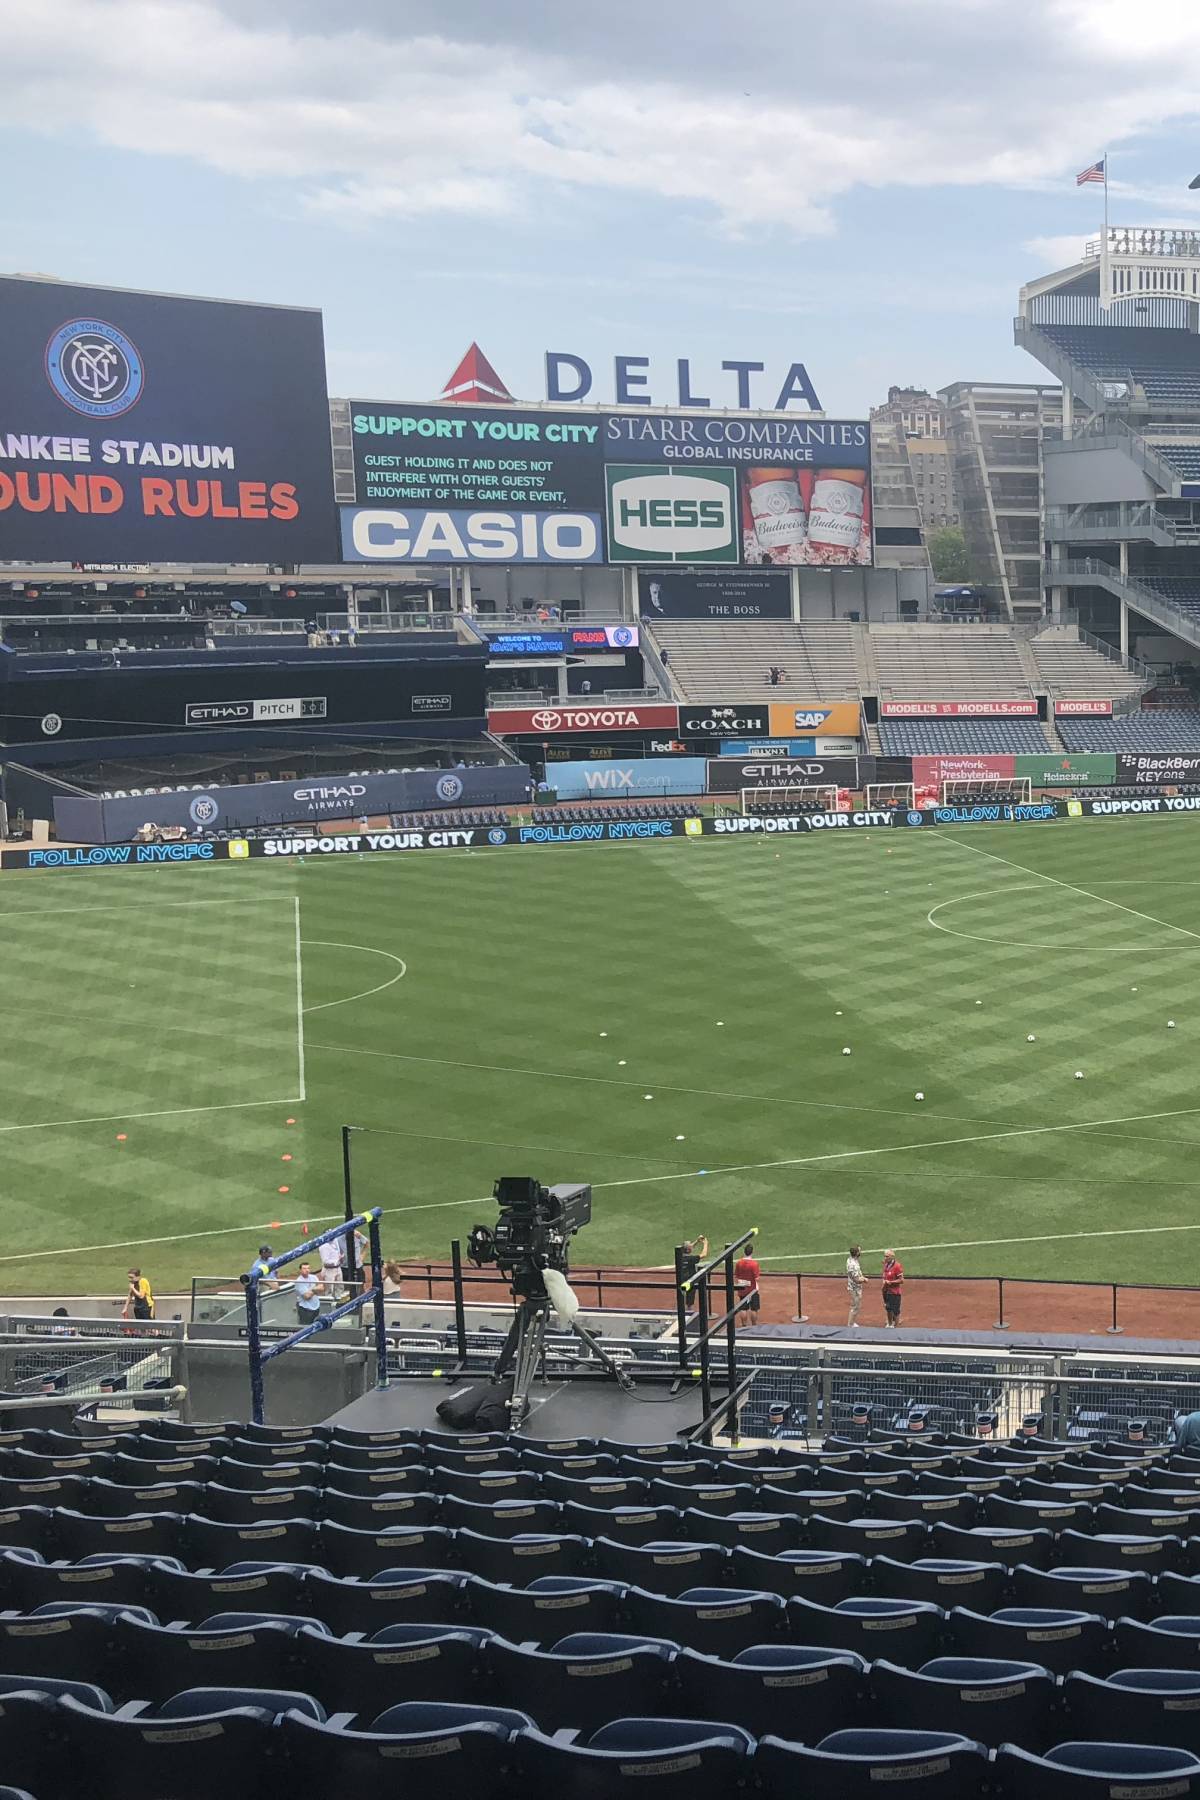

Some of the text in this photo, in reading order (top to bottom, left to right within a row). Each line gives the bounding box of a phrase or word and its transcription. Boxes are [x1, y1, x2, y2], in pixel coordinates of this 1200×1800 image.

[80, 323, 104, 332] YORK
[105, 329, 124, 343] CITY
[546, 351, 823, 411] DELTA
[353, 415, 599, 443] SUPPORT YOUR CITY
[607, 417, 866, 446] STARR COMPANIES
[102, 440, 235, 469] STADIUM
[663, 445, 813, 461] GLOBAL INSURANCE
[365, 455, 553, 472] GUEST HOLDING IT AND DOES NOT
[366, 472, 545, 487] INTERFERE WITH OTHER GUESTS'
[142, 477, 299, 519] RULES
[367, 487, 567, 503] ENJOYMENT OF THE GAME OR EVENT,
[620, 499, 724, 528] HESS
[352, 510, 597, 560] CASIO
[708, 605, 761, 615] THE BOSS
[573, 631, 605, 643] FANS
[526, 641, 564, 651] MATCH
[414, 697, 449, 705] ETIHAD
[886, 704, 938, 713] MODELL'S
[957, 703, 1033, 713] MODELLS.com
[1060, 703, 1107, 712] MODELL'S
[191, 704, 294, 718] ETIHAD PITCH
[563, 711, 640, 727] TOYOTA
[686, 719, 762, 730] COACH
[795, 712, 826, 727] SAP
[651, 740, 687, 752] FedEx
[741, 763, 824, 778] ETIHAD
[940, 760, 987, 770] NewYork-
[757, 778, 810, 787] AIRWAYS
[940, 770, 1000, 781] Presbyterian
[1043, 772, 1088, 781] Heineken
[294, 785, 367, 801] ETIHAD
[308, 799, 355, 810] AIRWAYS
[1092, 798, 1160, 814] SUPPORT
[714, 817, 800, 833] SUPPORT
[853, 812, 892, 826] CITY
[519, 821, 673, 842] FOLLOW NYCFC
[263, 830, 475, 855] SUPPORT YOUR CITY
[29, 843, 214, 866] FOLLOW NYCFC
